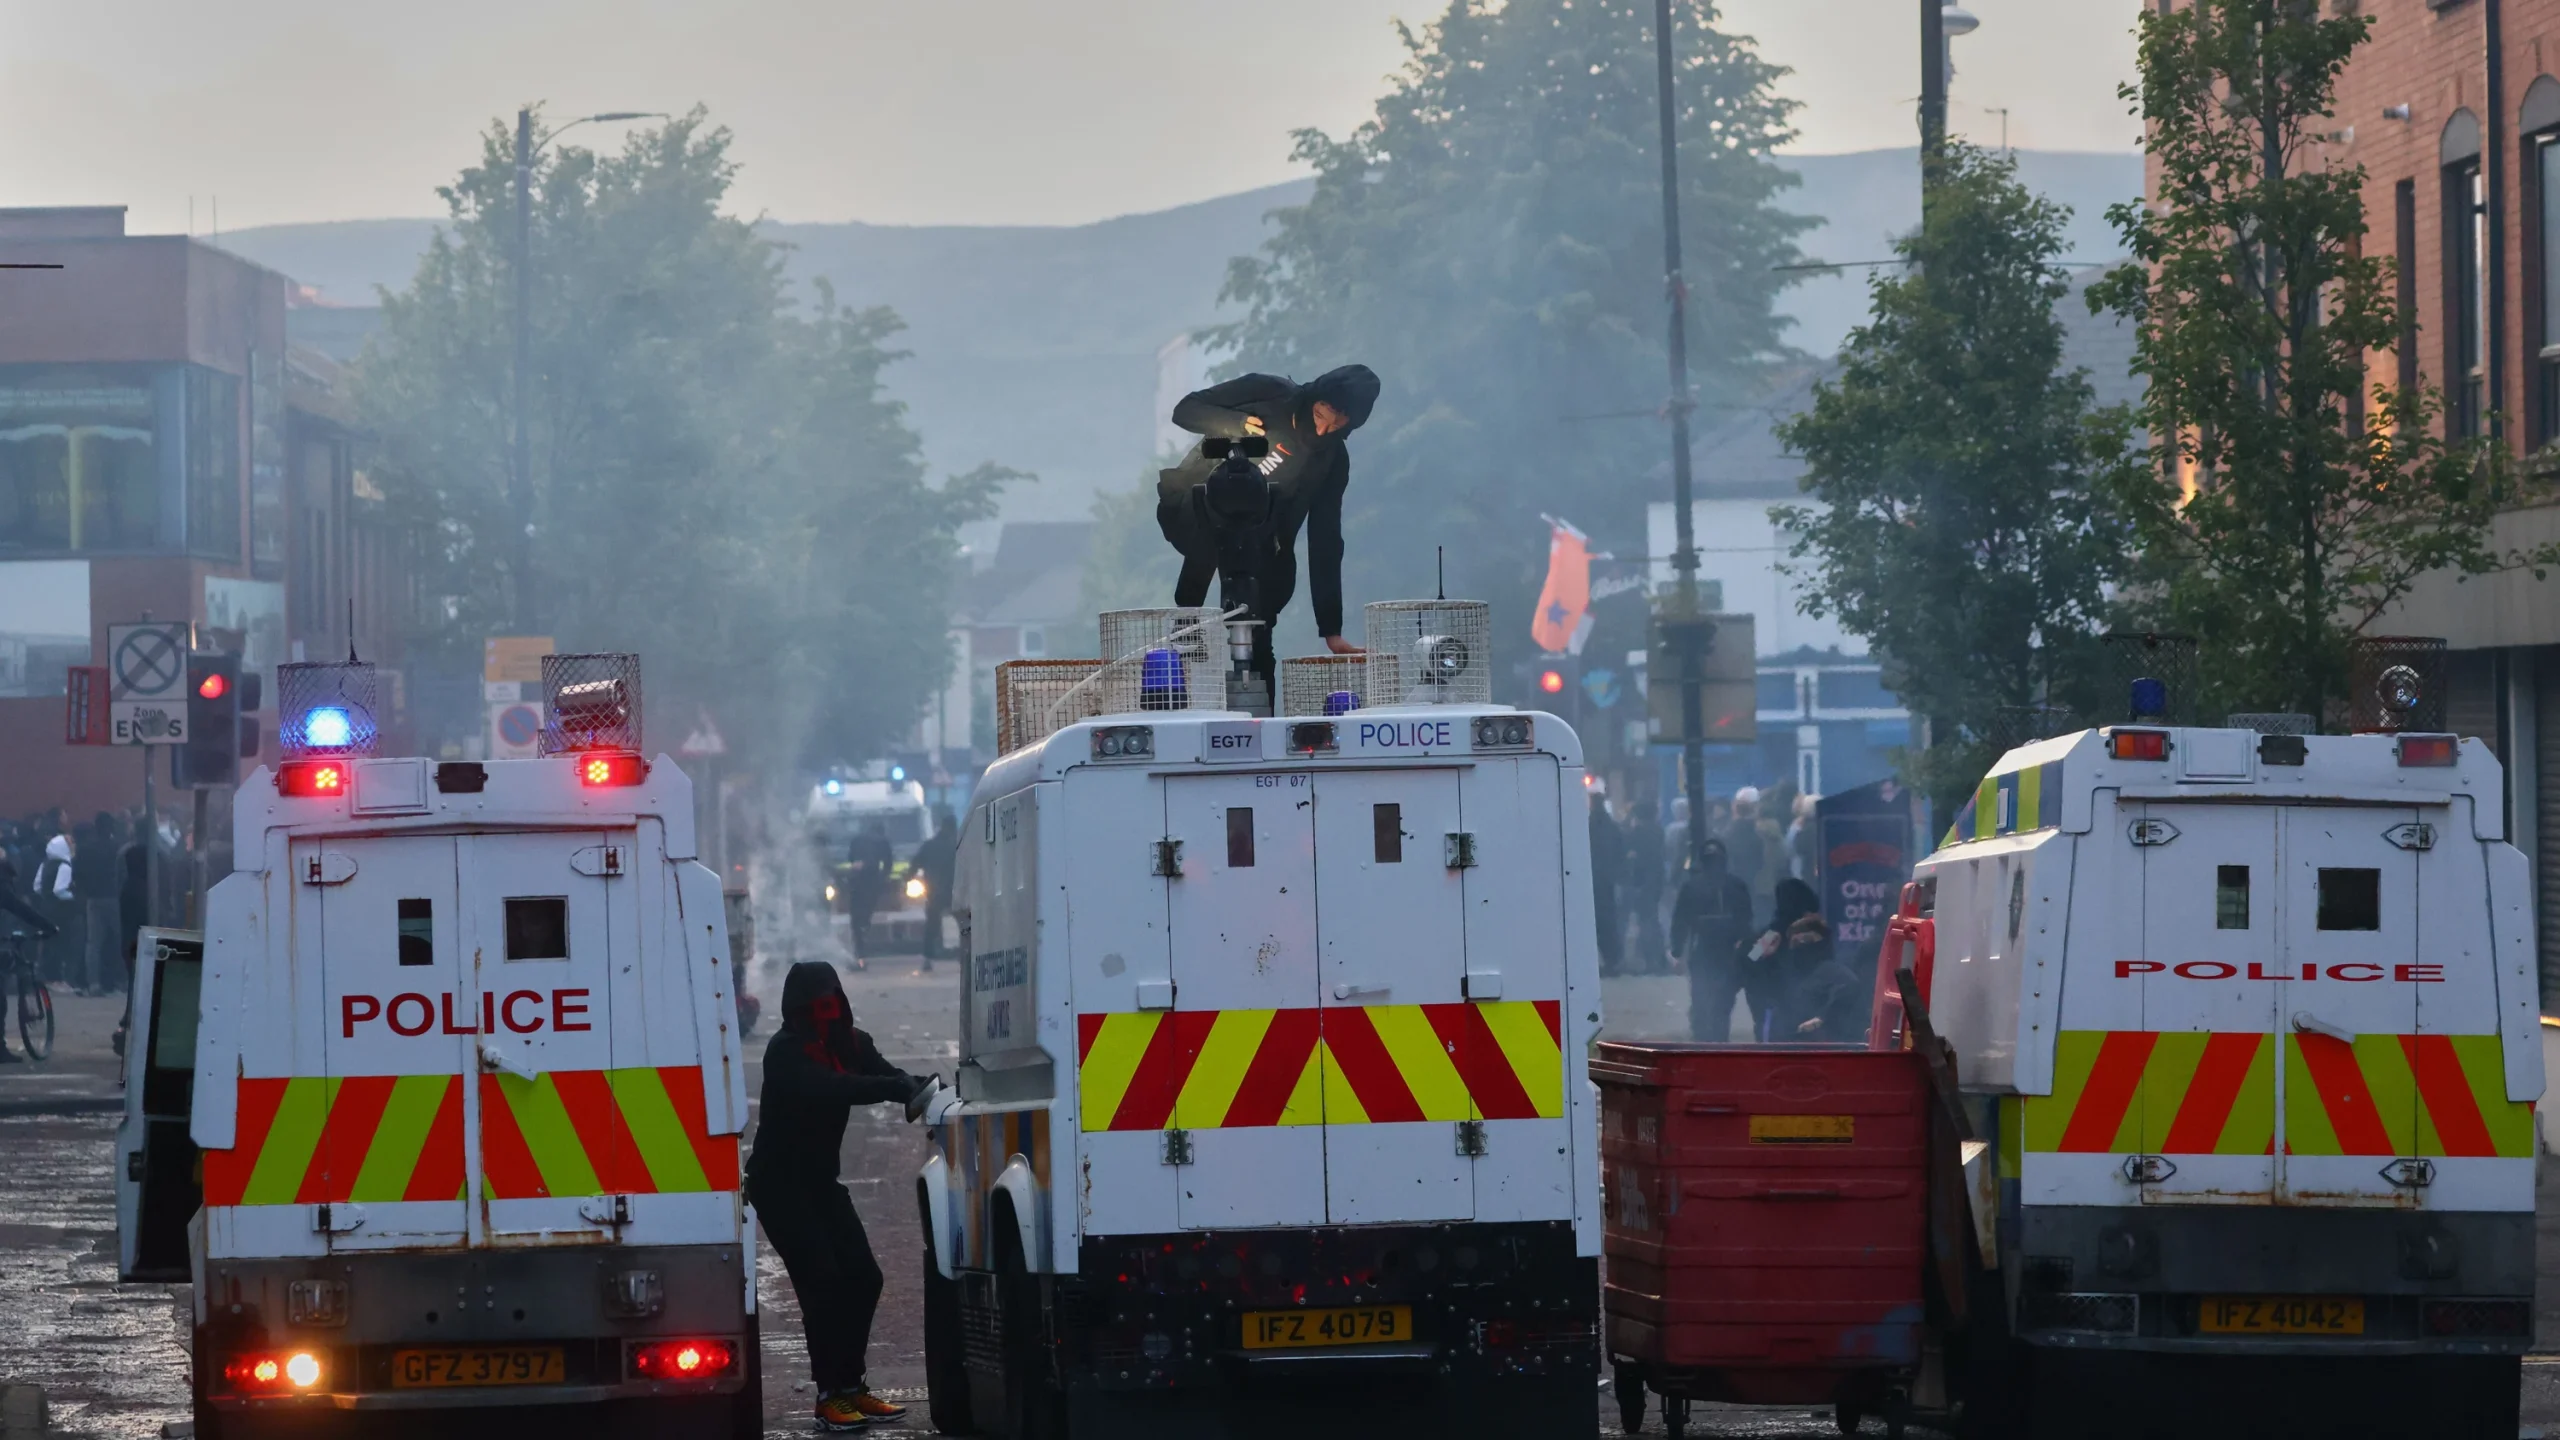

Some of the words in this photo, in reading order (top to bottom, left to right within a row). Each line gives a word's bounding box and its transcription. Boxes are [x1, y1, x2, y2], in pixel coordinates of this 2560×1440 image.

[1258, 451, 1283, 475] NIK
[116, 719, 182, 738] ENS
[1360, 722, 1451, 747] POLICE
[1211, 735, 1253, 748] EGT7
[1256, 775, 1281, 788] EGT
[2114, 960, 2445, 982] POLICE
[342, 988, 592, 1038] POLICE
[1258, 1316, 1305, 1342] IFZ
[1319, 1310, 1395, 1340] 4079
[2216, 1301, 2261, 1328] IFZ
[2270, 1302, 2345, 1329] 4042
[404, 1352, 463, 1383] GFZ
[472, 1350, 551, 1381] 3797
